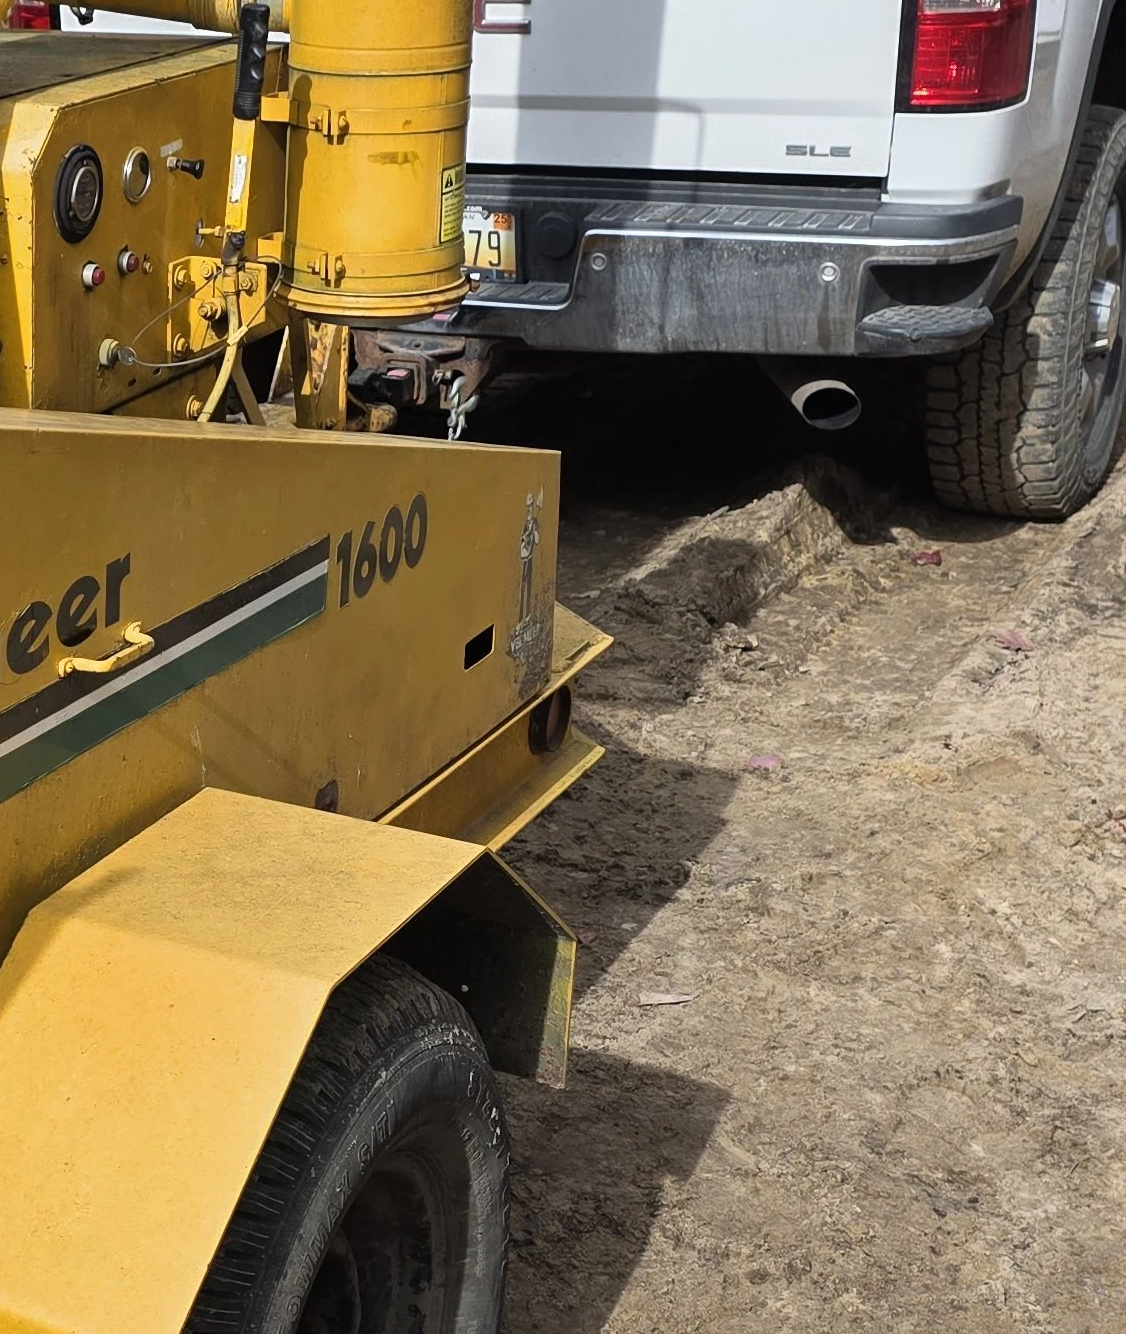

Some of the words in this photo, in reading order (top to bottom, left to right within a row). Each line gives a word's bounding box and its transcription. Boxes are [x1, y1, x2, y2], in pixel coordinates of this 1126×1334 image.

[786, 145, 851, 157] SLE
[494, 214, 508, 224] 25
[336, 492, 428, 609] 1600
